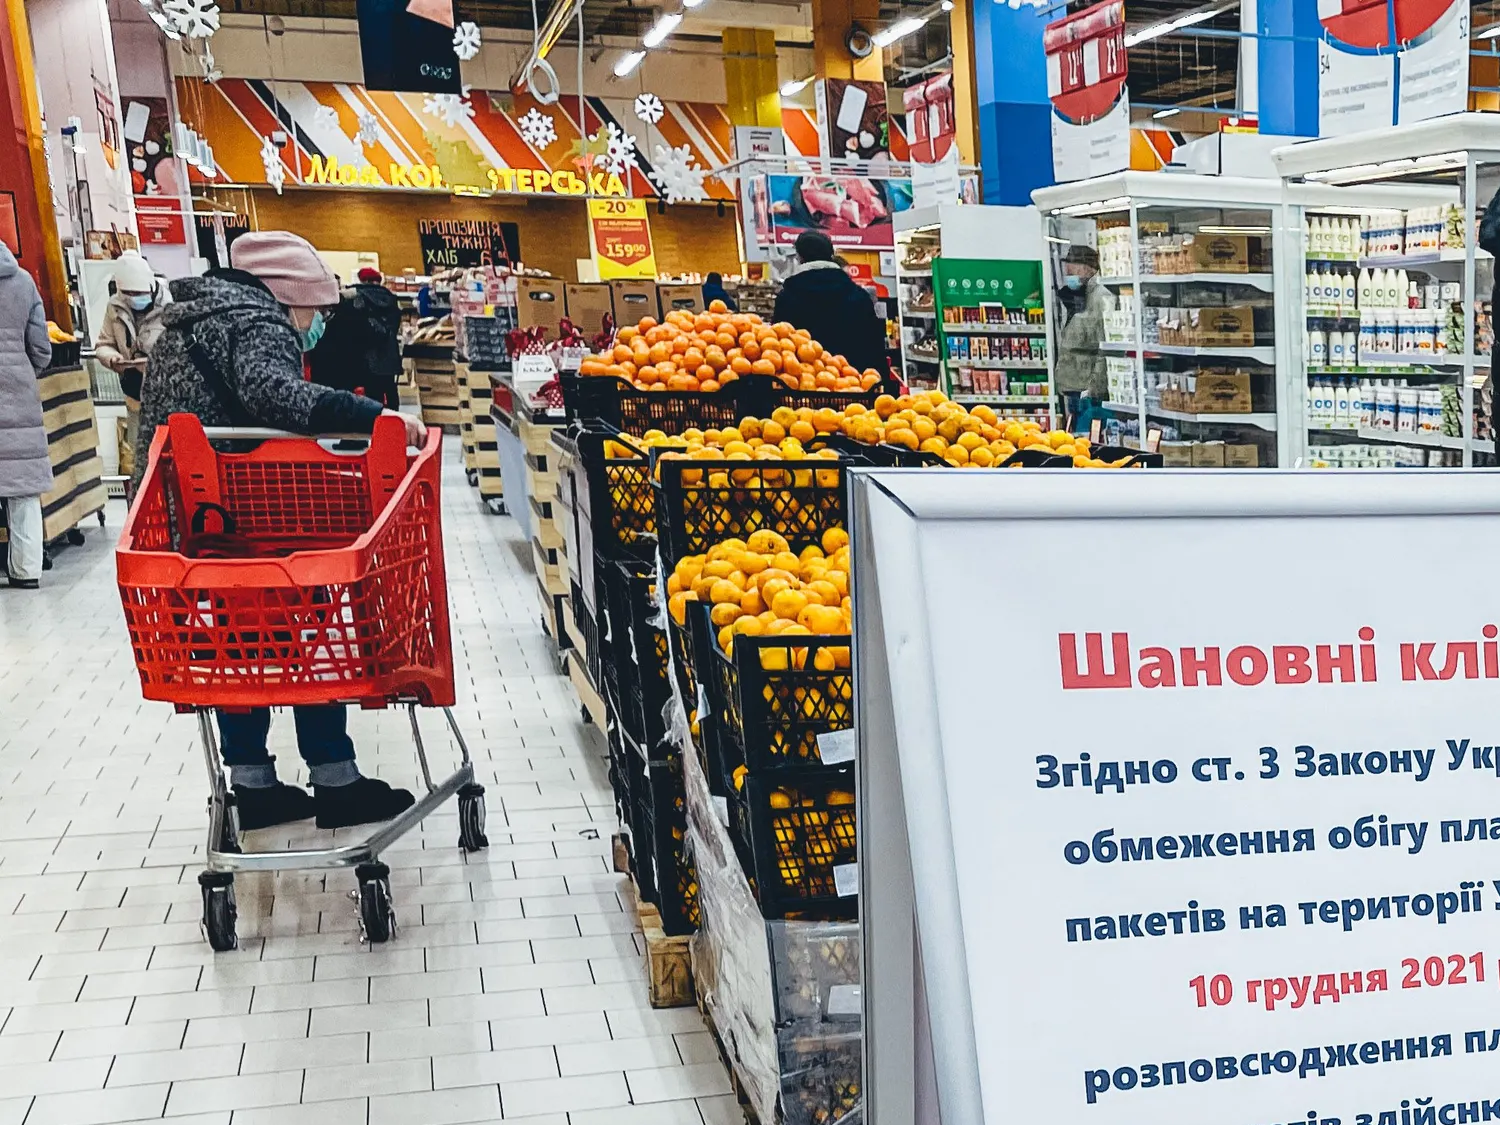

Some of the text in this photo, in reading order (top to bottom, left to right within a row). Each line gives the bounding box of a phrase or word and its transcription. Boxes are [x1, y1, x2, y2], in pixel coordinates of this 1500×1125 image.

[305, 154, 382, 186] Моя
[426, 249, 458, 265] ХЛІБ
[1058, 626, 1377, 690] Шановні
[1035, 752, 1178, 794] Згідно
[1191, 757, 1245, 782] ст.
[1259, 746, 1280, 779] 3
[1294, 745, 1436, 782] Закону
[1063, 828, 1315, 865] обмеження
[1328, 814, 1429, 855] обігу
[1065, 899, 1226, 942] пакетів
[1239, 904, 1287, 930] на
[1298, 880, 1485, 932] території
[1189, 973, 1233, 1008] 10
[1246, 969, 1388, 1011] грудня
[1401, 951, 1485, 989] 2021
[1084, 1033, 1452, 1105] розповсюдження
